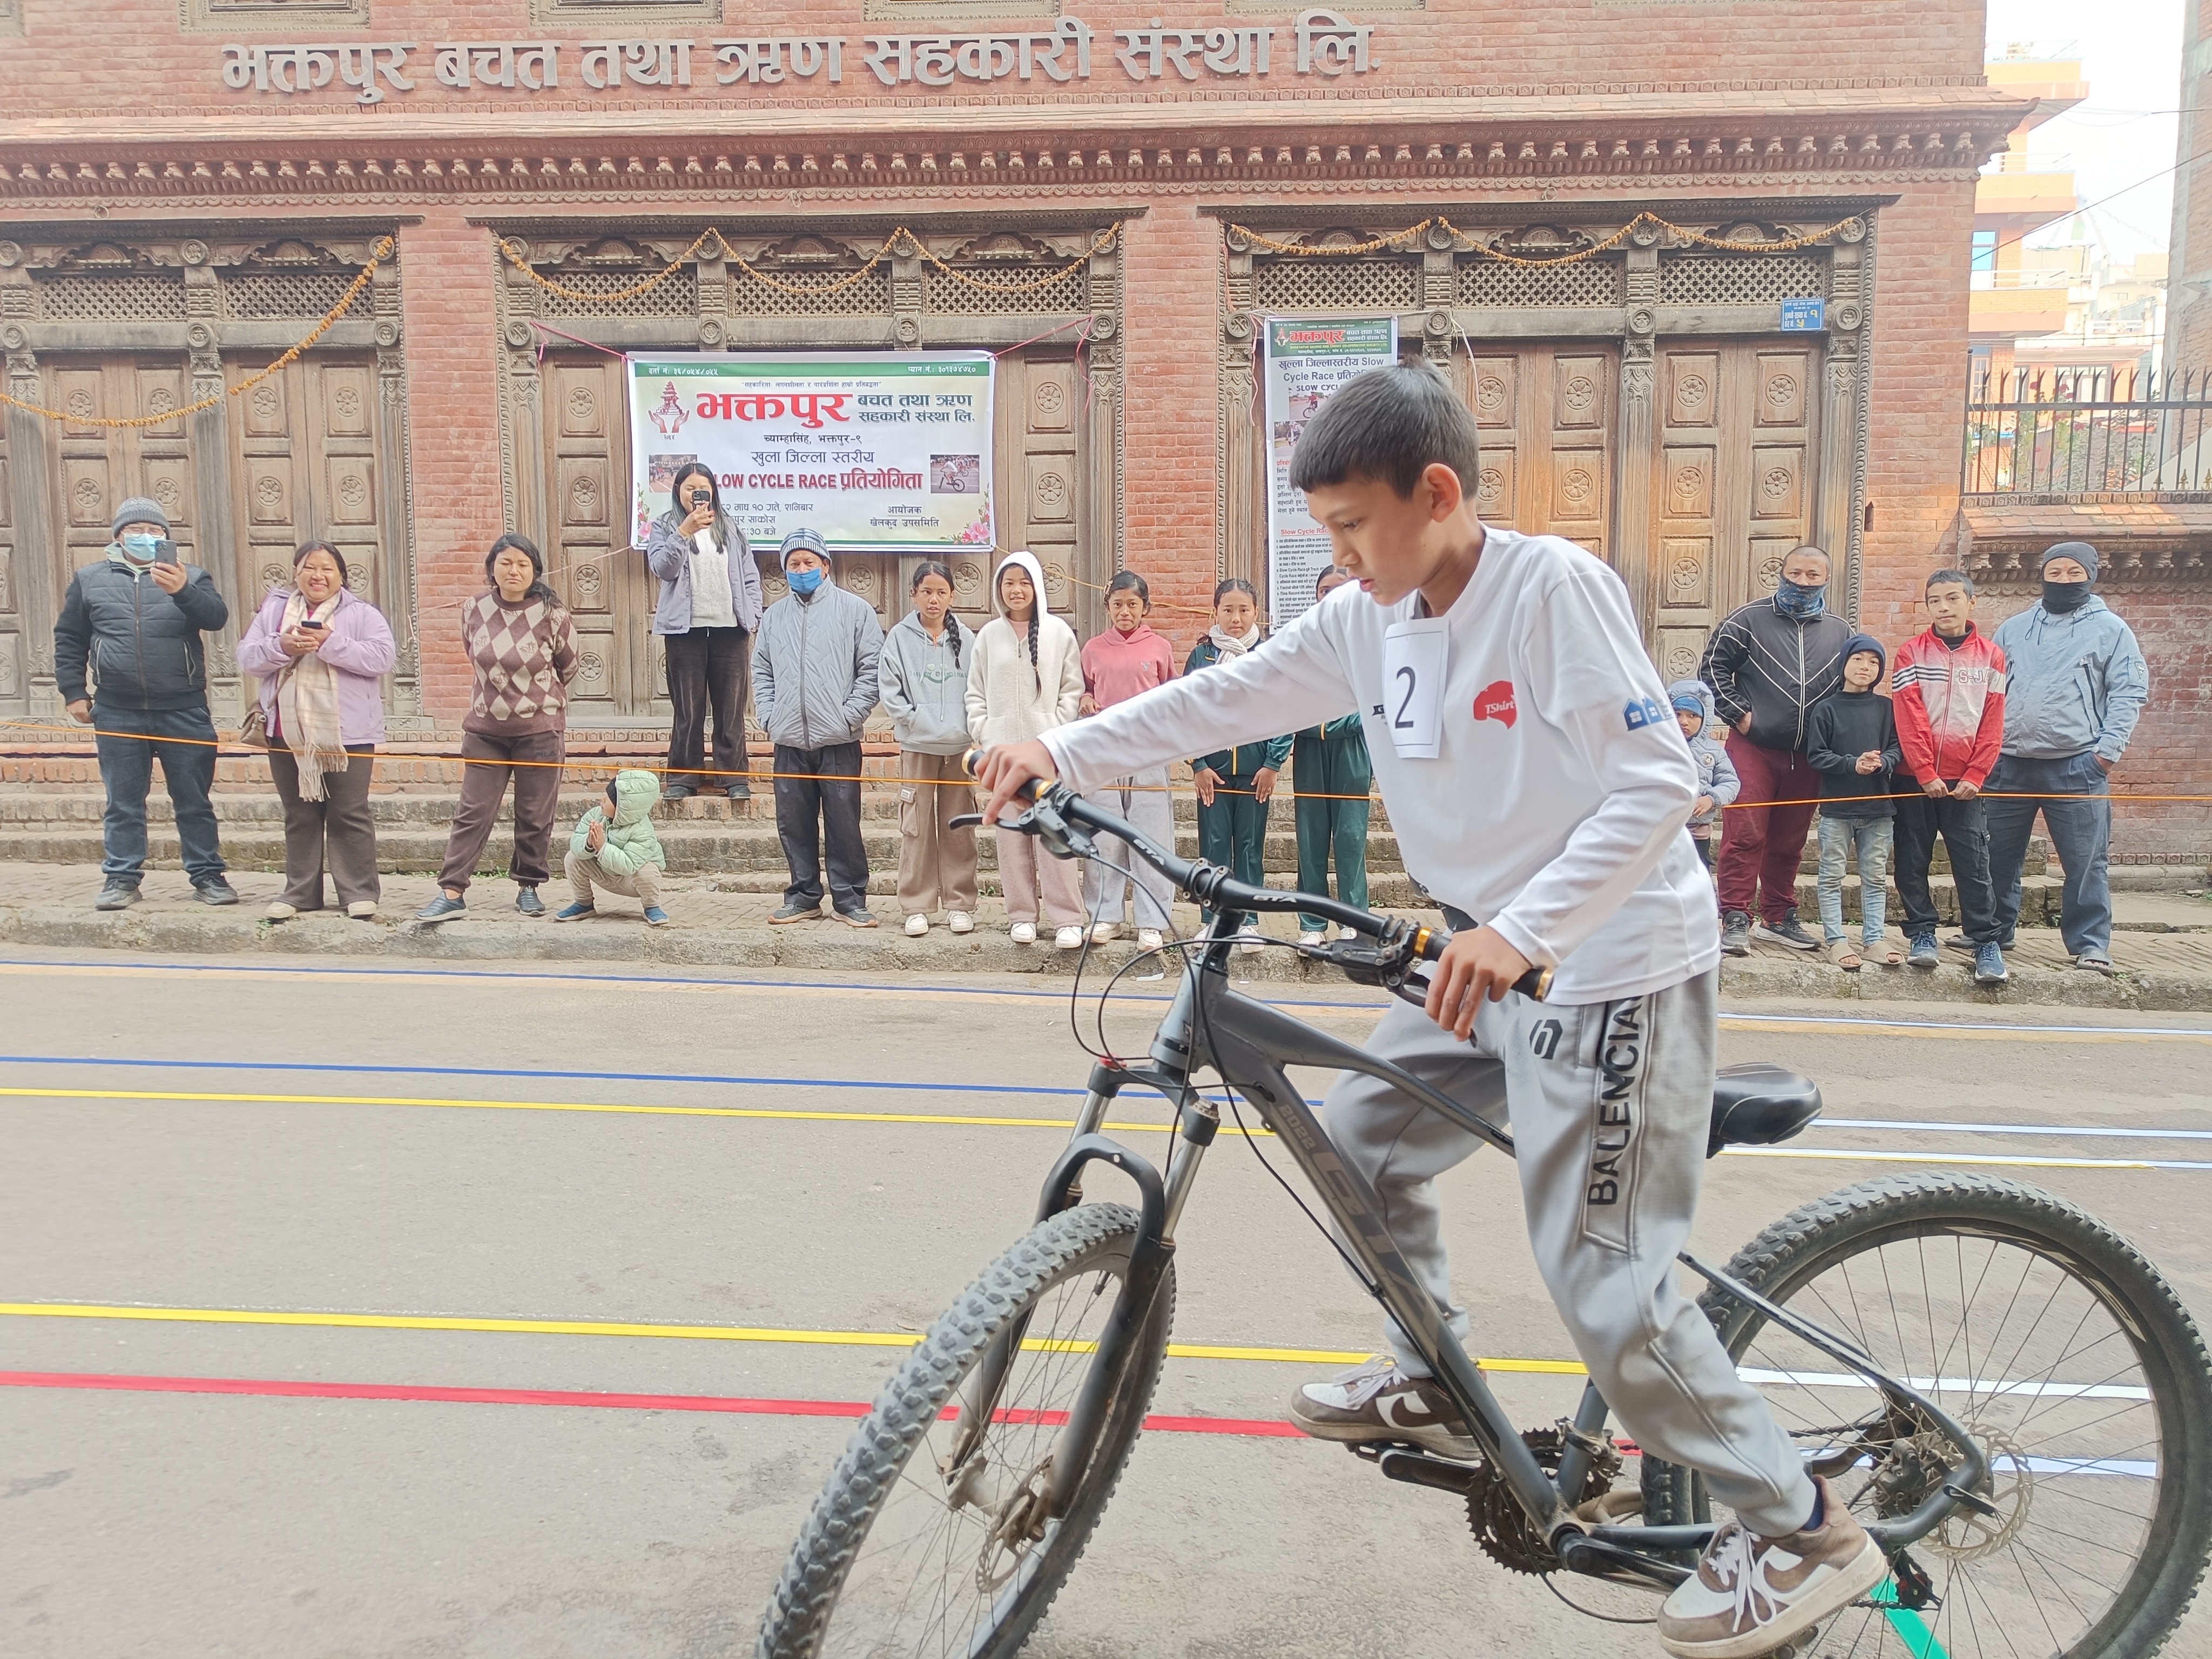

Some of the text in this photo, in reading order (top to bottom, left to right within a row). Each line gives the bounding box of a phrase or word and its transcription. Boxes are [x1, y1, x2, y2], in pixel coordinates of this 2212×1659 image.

[222, 8, 1381, 103] भक्तपुर बचत तथा ऋण सहकारी संस्था लि.
[1810, 309, 1818, 318] १
[1290, 329, 1346, 345] भक्तपुर
[1278, 357, 1384, 370] खुल्ला जिल्लास्तरीय Slow
[673, 368, 719, 376] ३६/०५४/०५५
[1284, 369, 1367, 383] Cycle Race प्रतियो
[696, 393, 973, 429] भक्तपुर बचत तथा ऋण
[858, 408, 975, 422] सहकारी संस्था लि.
[763, 433, 862, 446] च्याम्हासिंह, भक्तपुर-९
[751, 449, 875, 467] खुला जिल्ला स्तरीय
[713, 467, 923, 490] LOW CYCLE RACE प्रतियोगिता
[752, 503, 764, 511] १०
[766, 501, 781, 512] गते,
[785, 501, 814, 511] शनिबार
[887, 504, 922, 514] आयोजक
[747, 514, 775, 524] साकोस
[870, 517, 940, 530] खेलकुद उपसमिति
[764, 525, 776, 536] बजे
[1394, 666, 1415, 729] 2
[1484, 700, 1515, 714] TShirt
[1587, 996, 1644, 1206] BALENCIA
[1278, 1104, 1317, 1150] 2022
